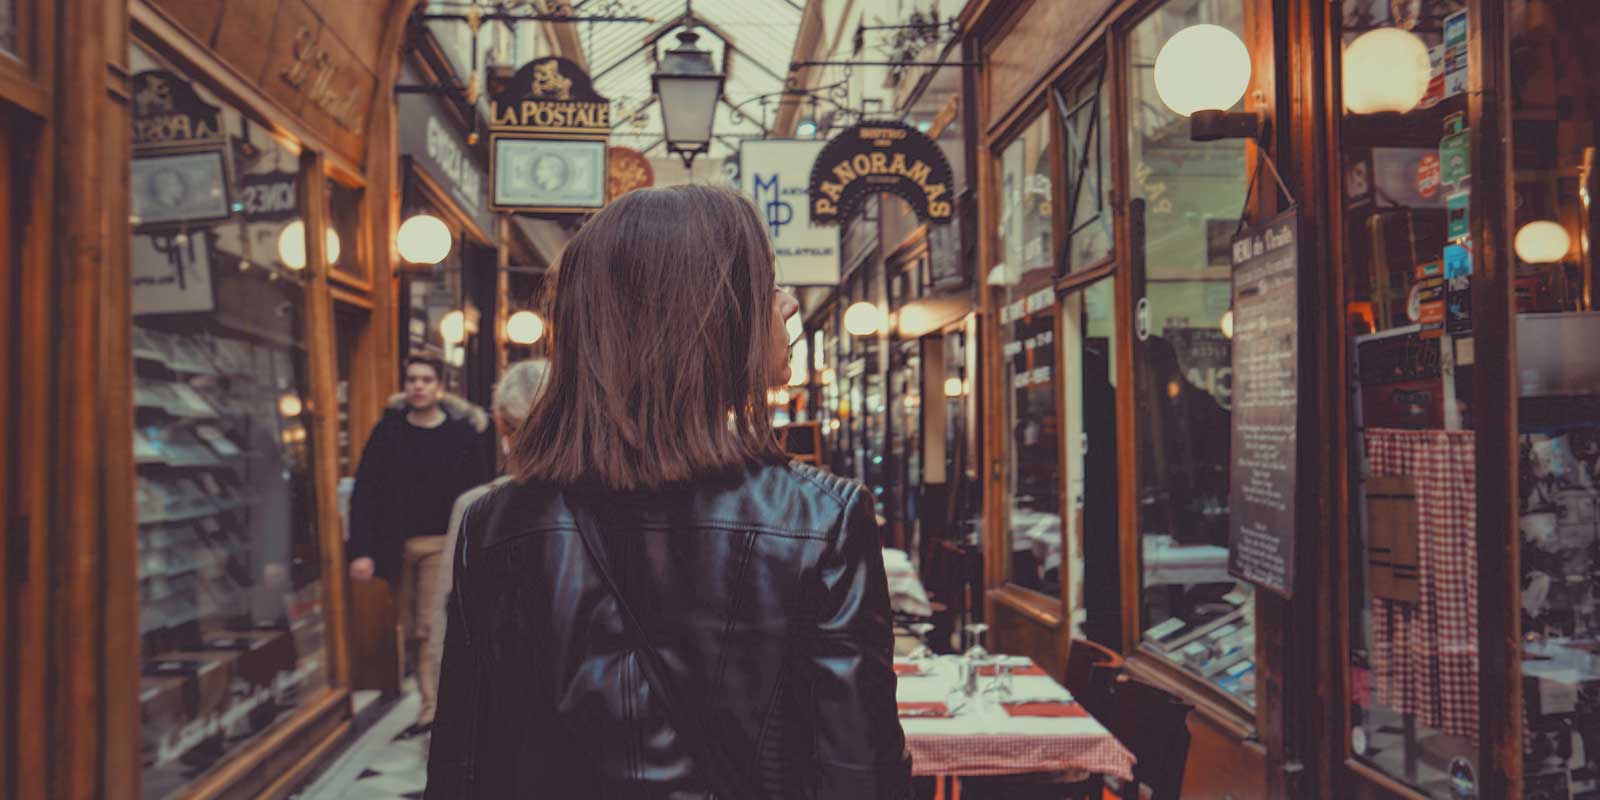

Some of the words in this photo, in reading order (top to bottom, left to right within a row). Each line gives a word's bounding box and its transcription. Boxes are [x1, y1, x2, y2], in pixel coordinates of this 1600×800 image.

[491, 100, 517, 126] LA
[521, 99, 609, 127] POSTALE
[815, 151, 952, 219] PANORAMAS
